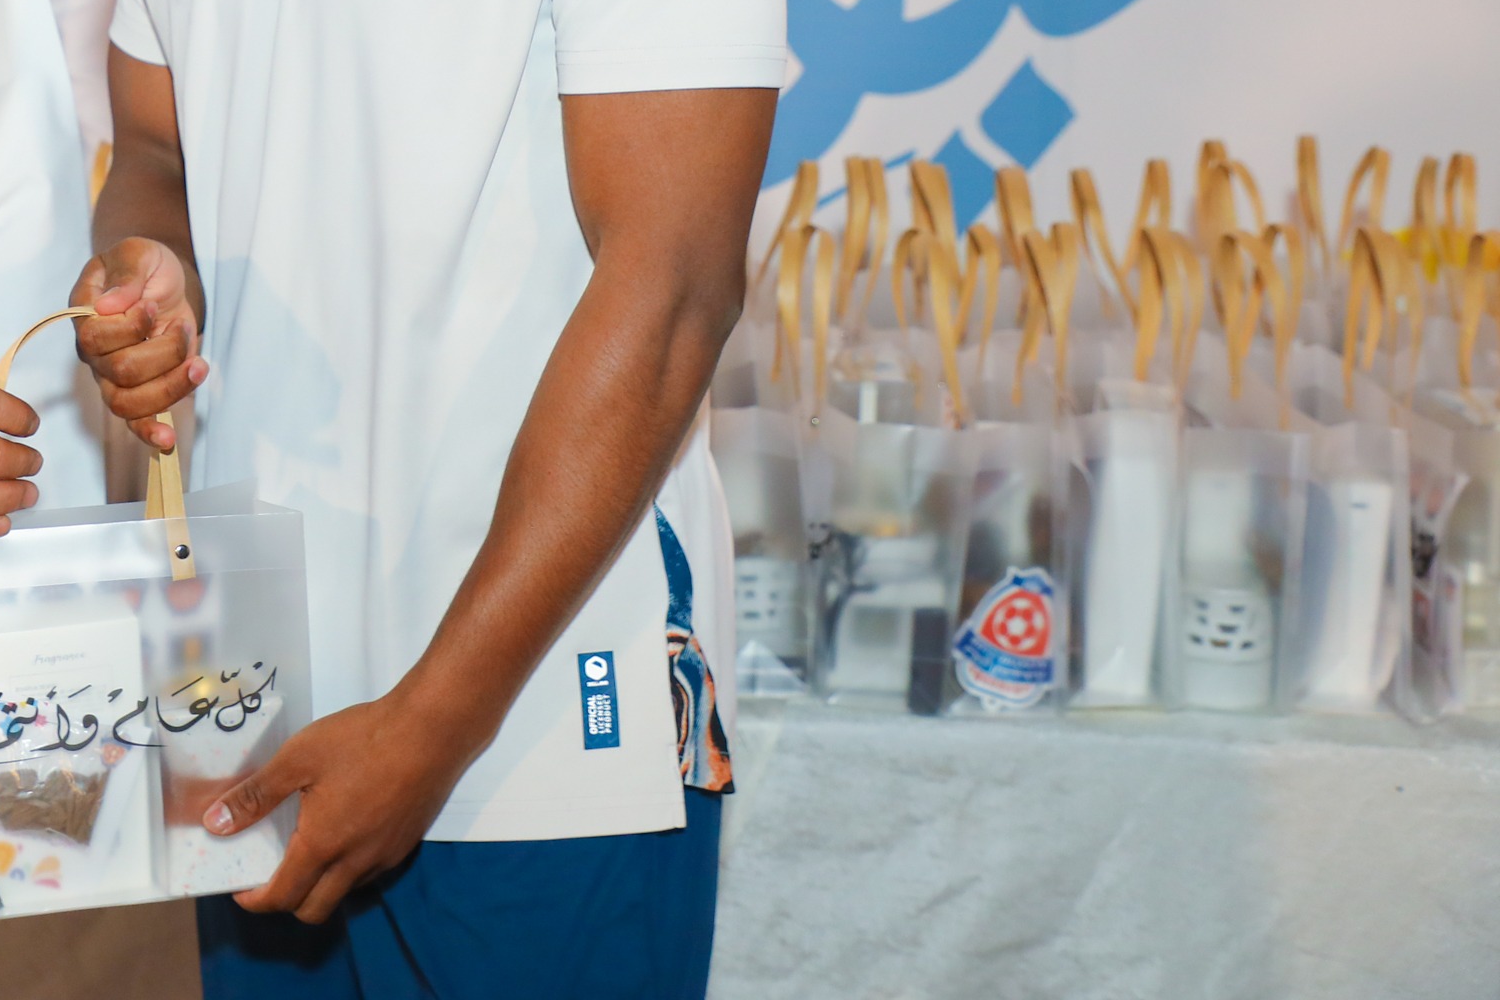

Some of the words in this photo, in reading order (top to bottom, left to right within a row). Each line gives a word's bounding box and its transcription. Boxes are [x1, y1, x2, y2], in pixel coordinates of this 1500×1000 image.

[587, 695, 598, 735] OFFICIAL
[597, 694, 605, 734] LICENSED
[604, 694, 612, 733] PRODUCT
